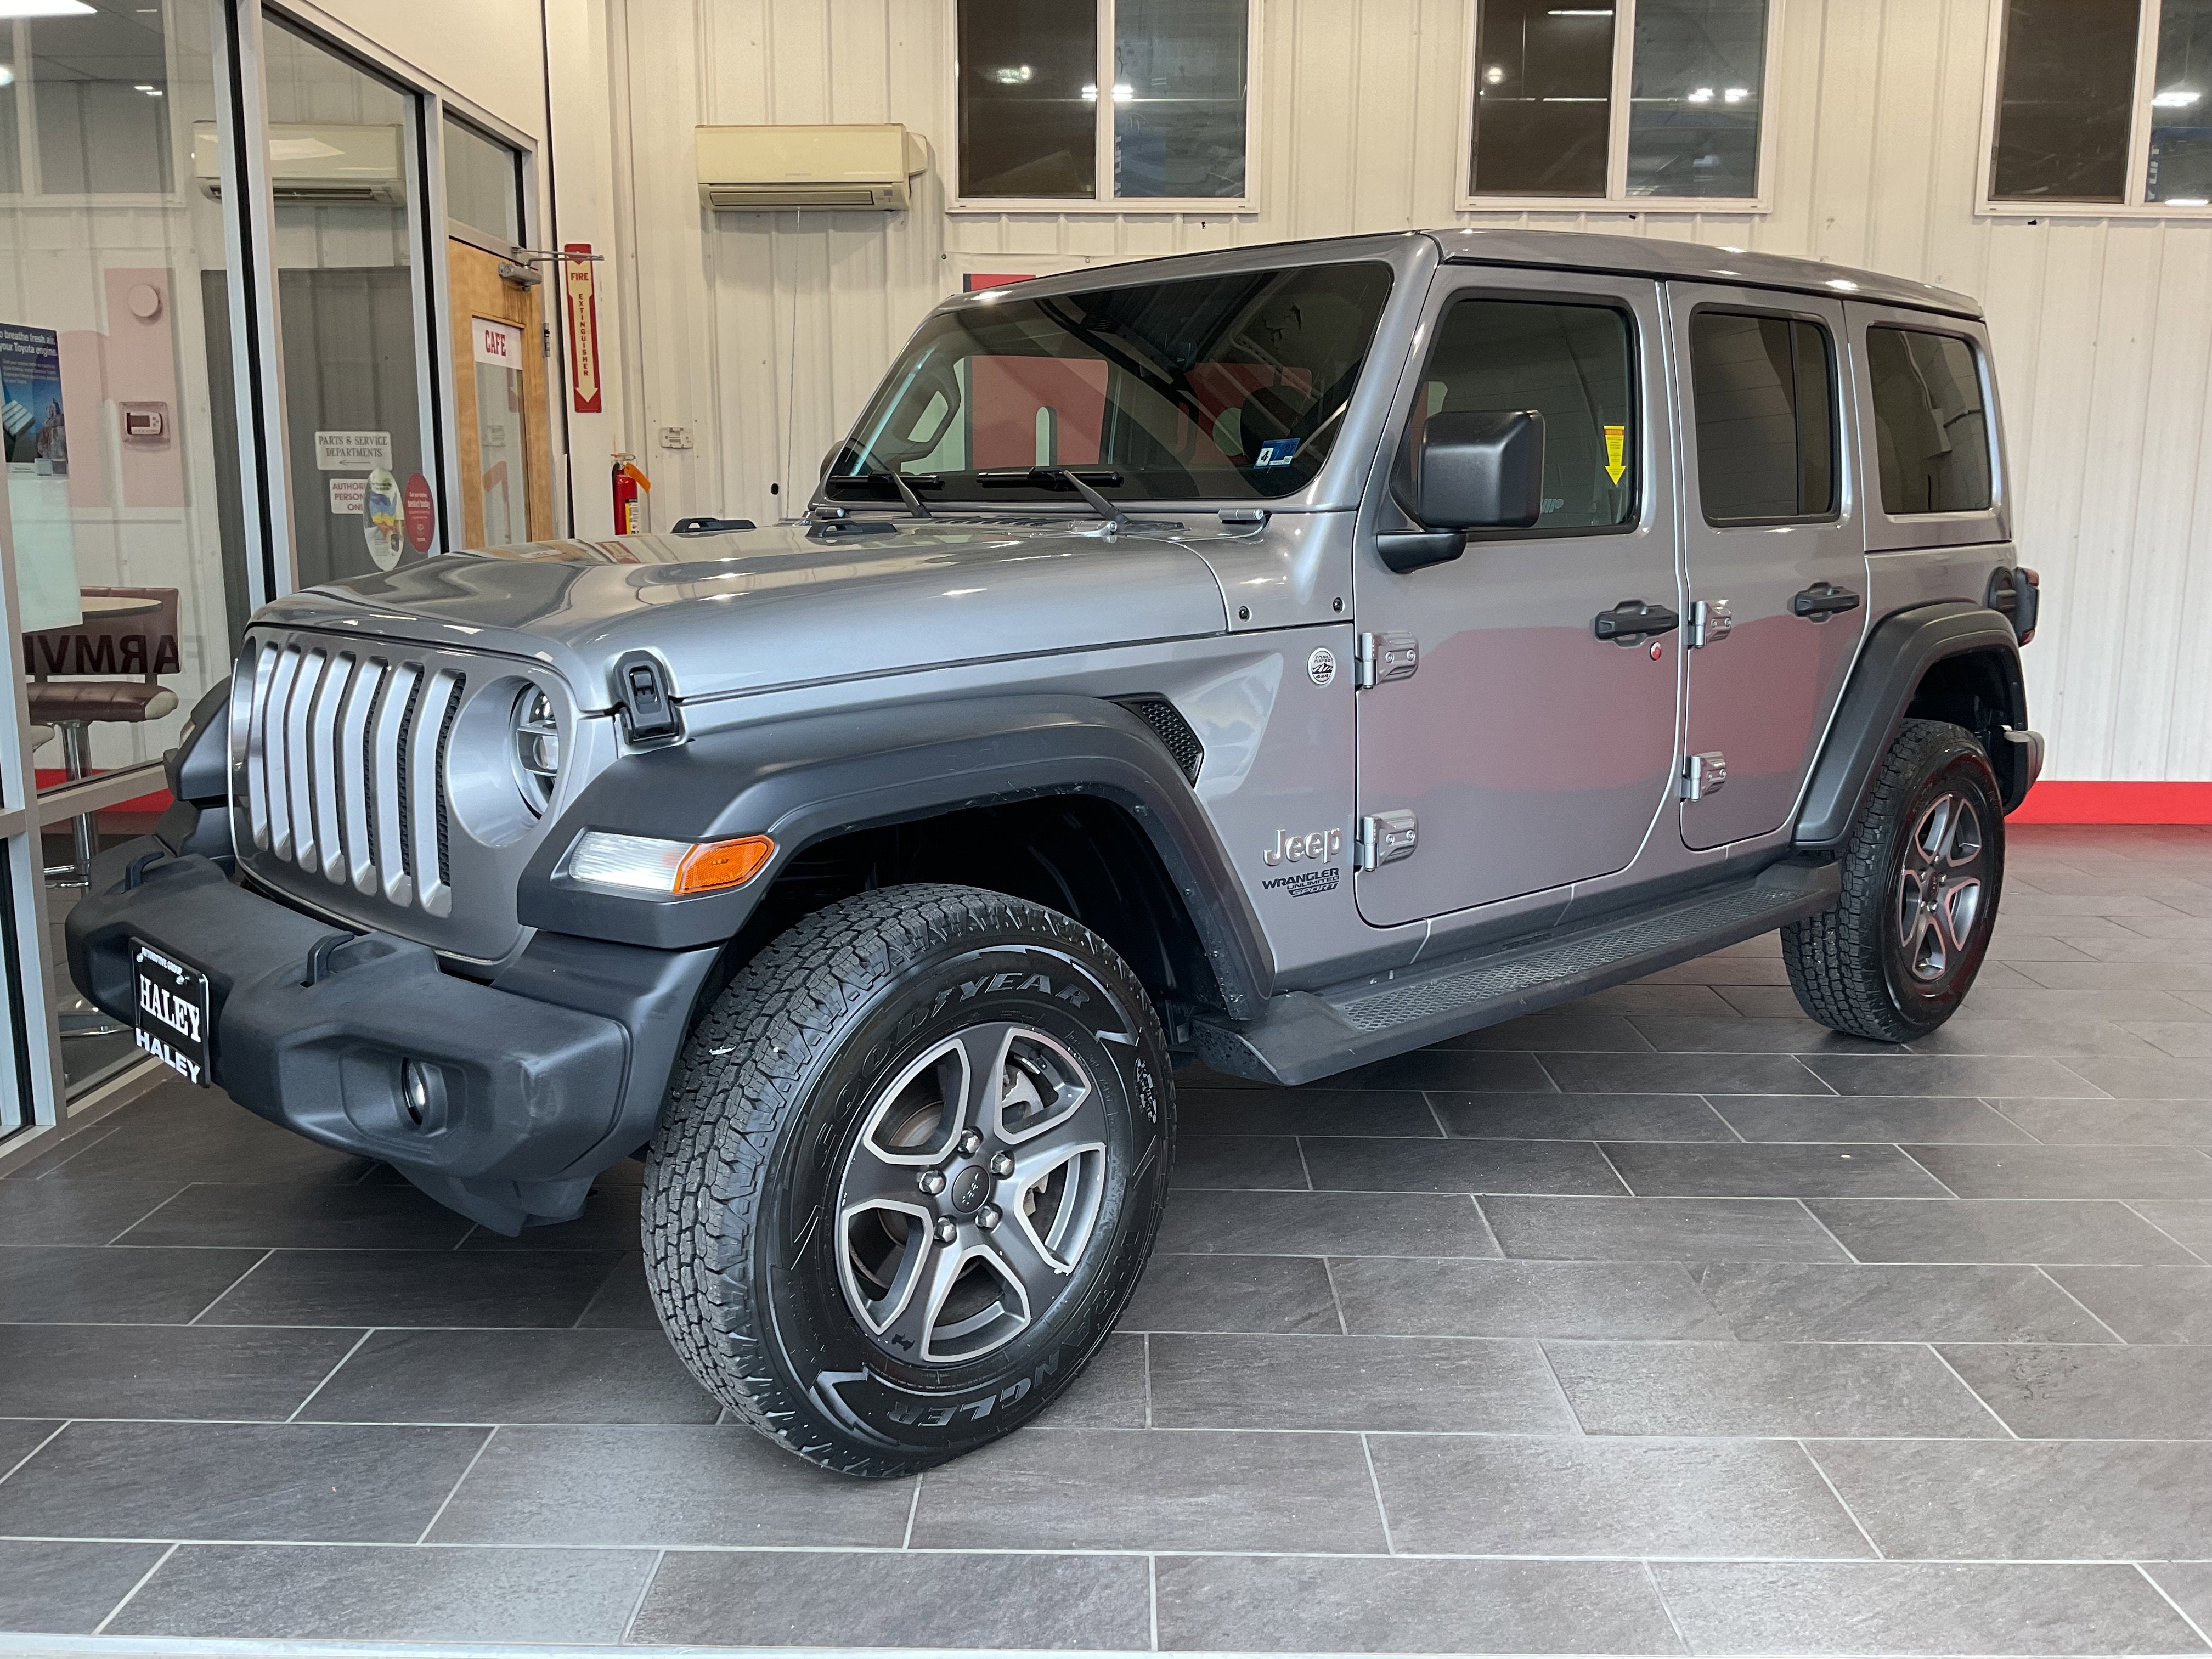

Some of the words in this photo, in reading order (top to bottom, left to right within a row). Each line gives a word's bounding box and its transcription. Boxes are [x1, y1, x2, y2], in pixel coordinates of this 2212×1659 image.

[571, 273, 589, 281] FIRE
[4, 329, 29, 342] breathe
[30, 333, 46, 343] fresh
[578, 294, 588, 376] EXTINGUISHER
[14, 342, 35, 354] Toyota
[485, 330, 506, 356] CAFE
[319, 436, 343, 445] PARTS
[346, 436, 352, 445] &
[355, 436, 388, 445] SERVICE
[326, 448, 382, 458] DEPARTMENTS
[1261, 450, 1269, 462] 4
[1263, 828, 1342, 866] Jeep
[1262, 868, 1339, 890] WRANGLER
[1287, 876, 1339, 889] UNLIMITED
[1290, 883, 1338, 896] SPORT
[140, 973, 201, 1043] HALEY
[136, 1027, 201, 1084] HALEY
